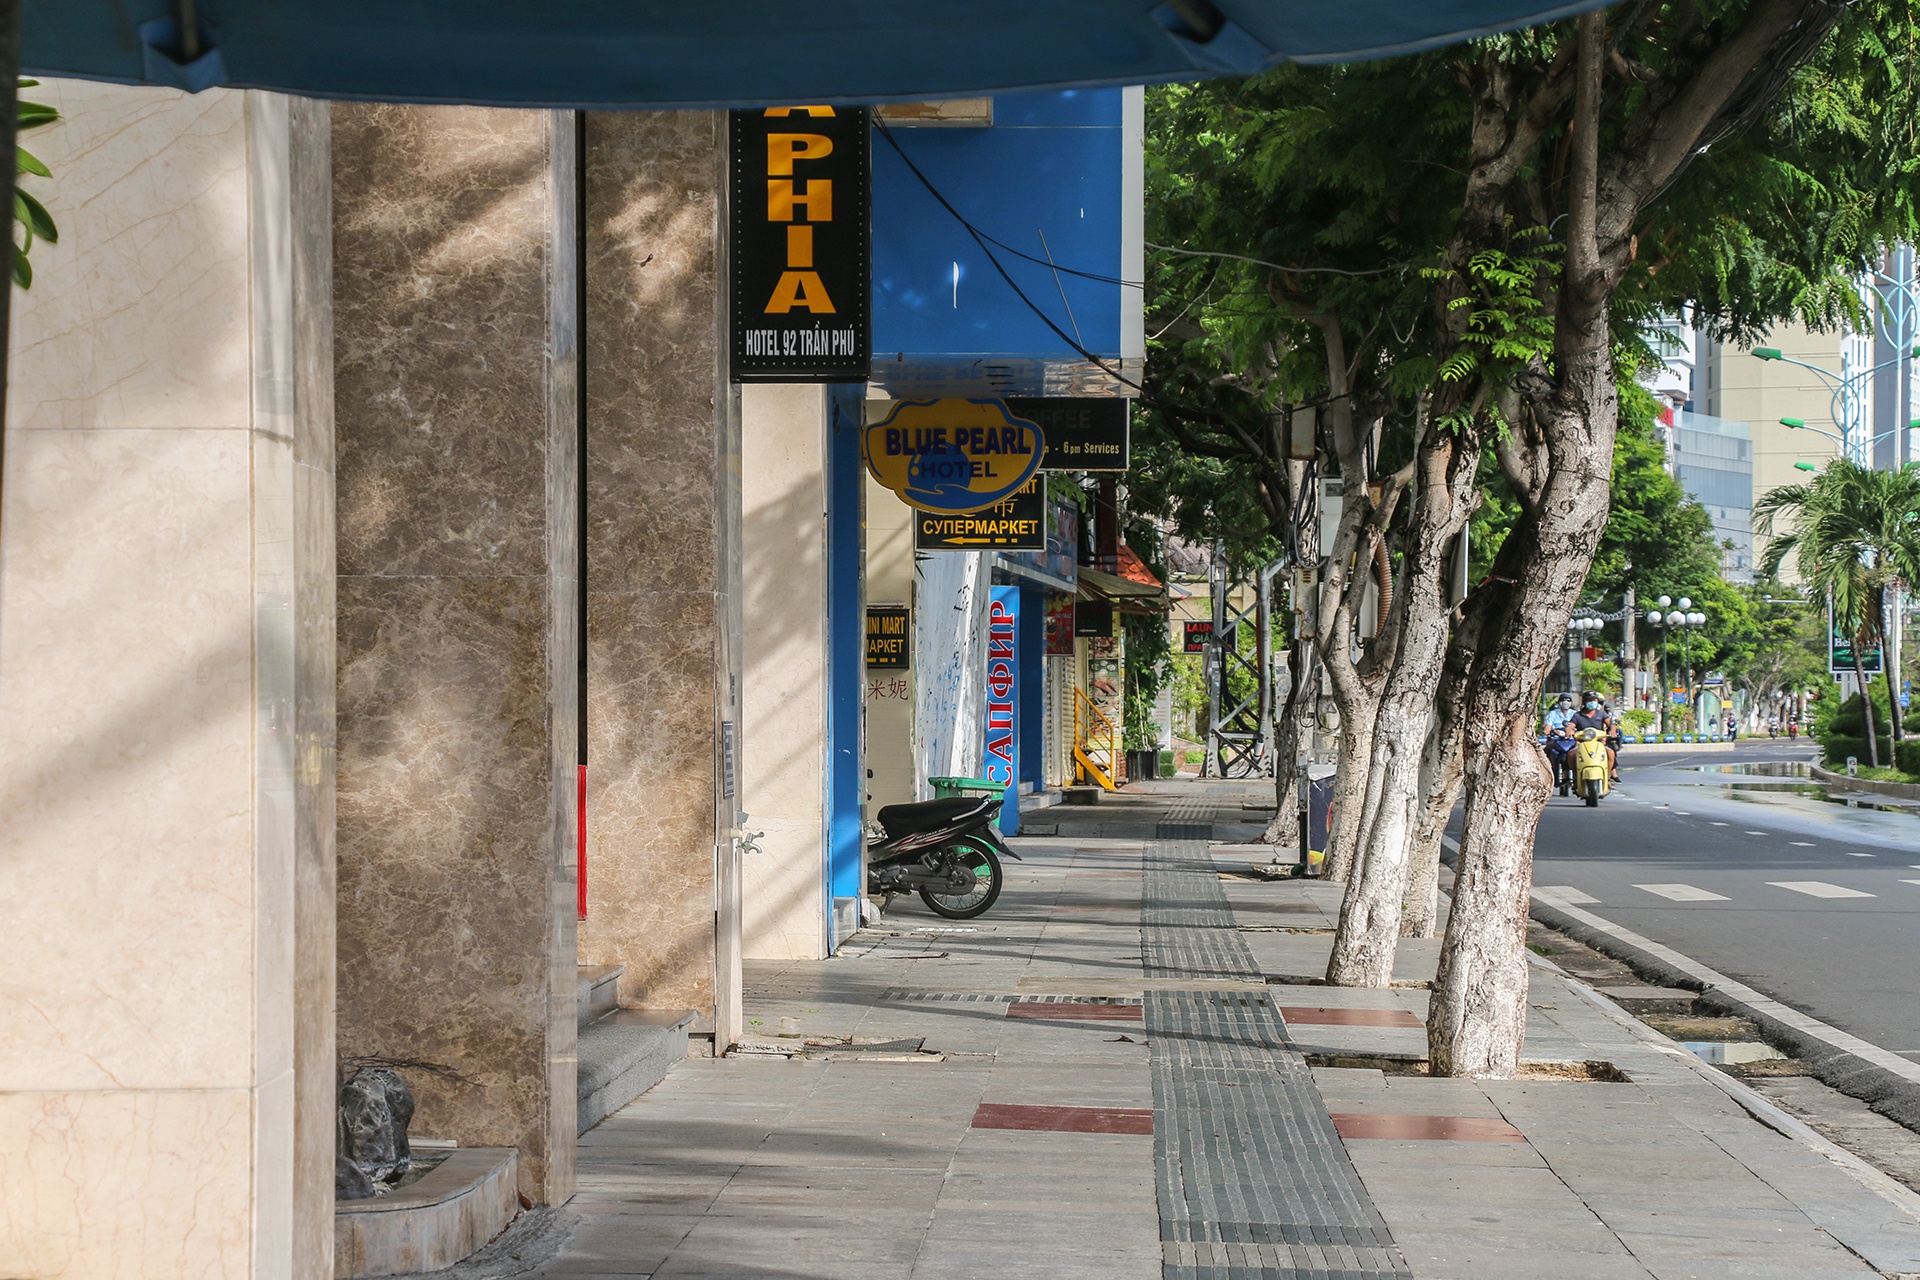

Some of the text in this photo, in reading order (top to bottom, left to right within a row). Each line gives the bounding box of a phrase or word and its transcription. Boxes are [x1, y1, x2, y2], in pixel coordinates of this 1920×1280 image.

[763, 105, 837, 314] PHIA
[746, 320, 855, 356] HOTEL 92 TRẦN PHÚ
[886, 427, 1031, 456] BLUE PEARL
[1063, 441, 1081, 455] 6pm
[1084, 442, 1120, 454] Services
[921, 461, 998, 478] HOTEL
[1018, 479, 1037, 494] RT
[923, 520, 1038, 535] СУПЕРМАРКЕТ
[882, 616, 905, 634] MART
[866, 639, 904, 653] АРКЕТ
[987, 600, 1015, 789] САПФИР
